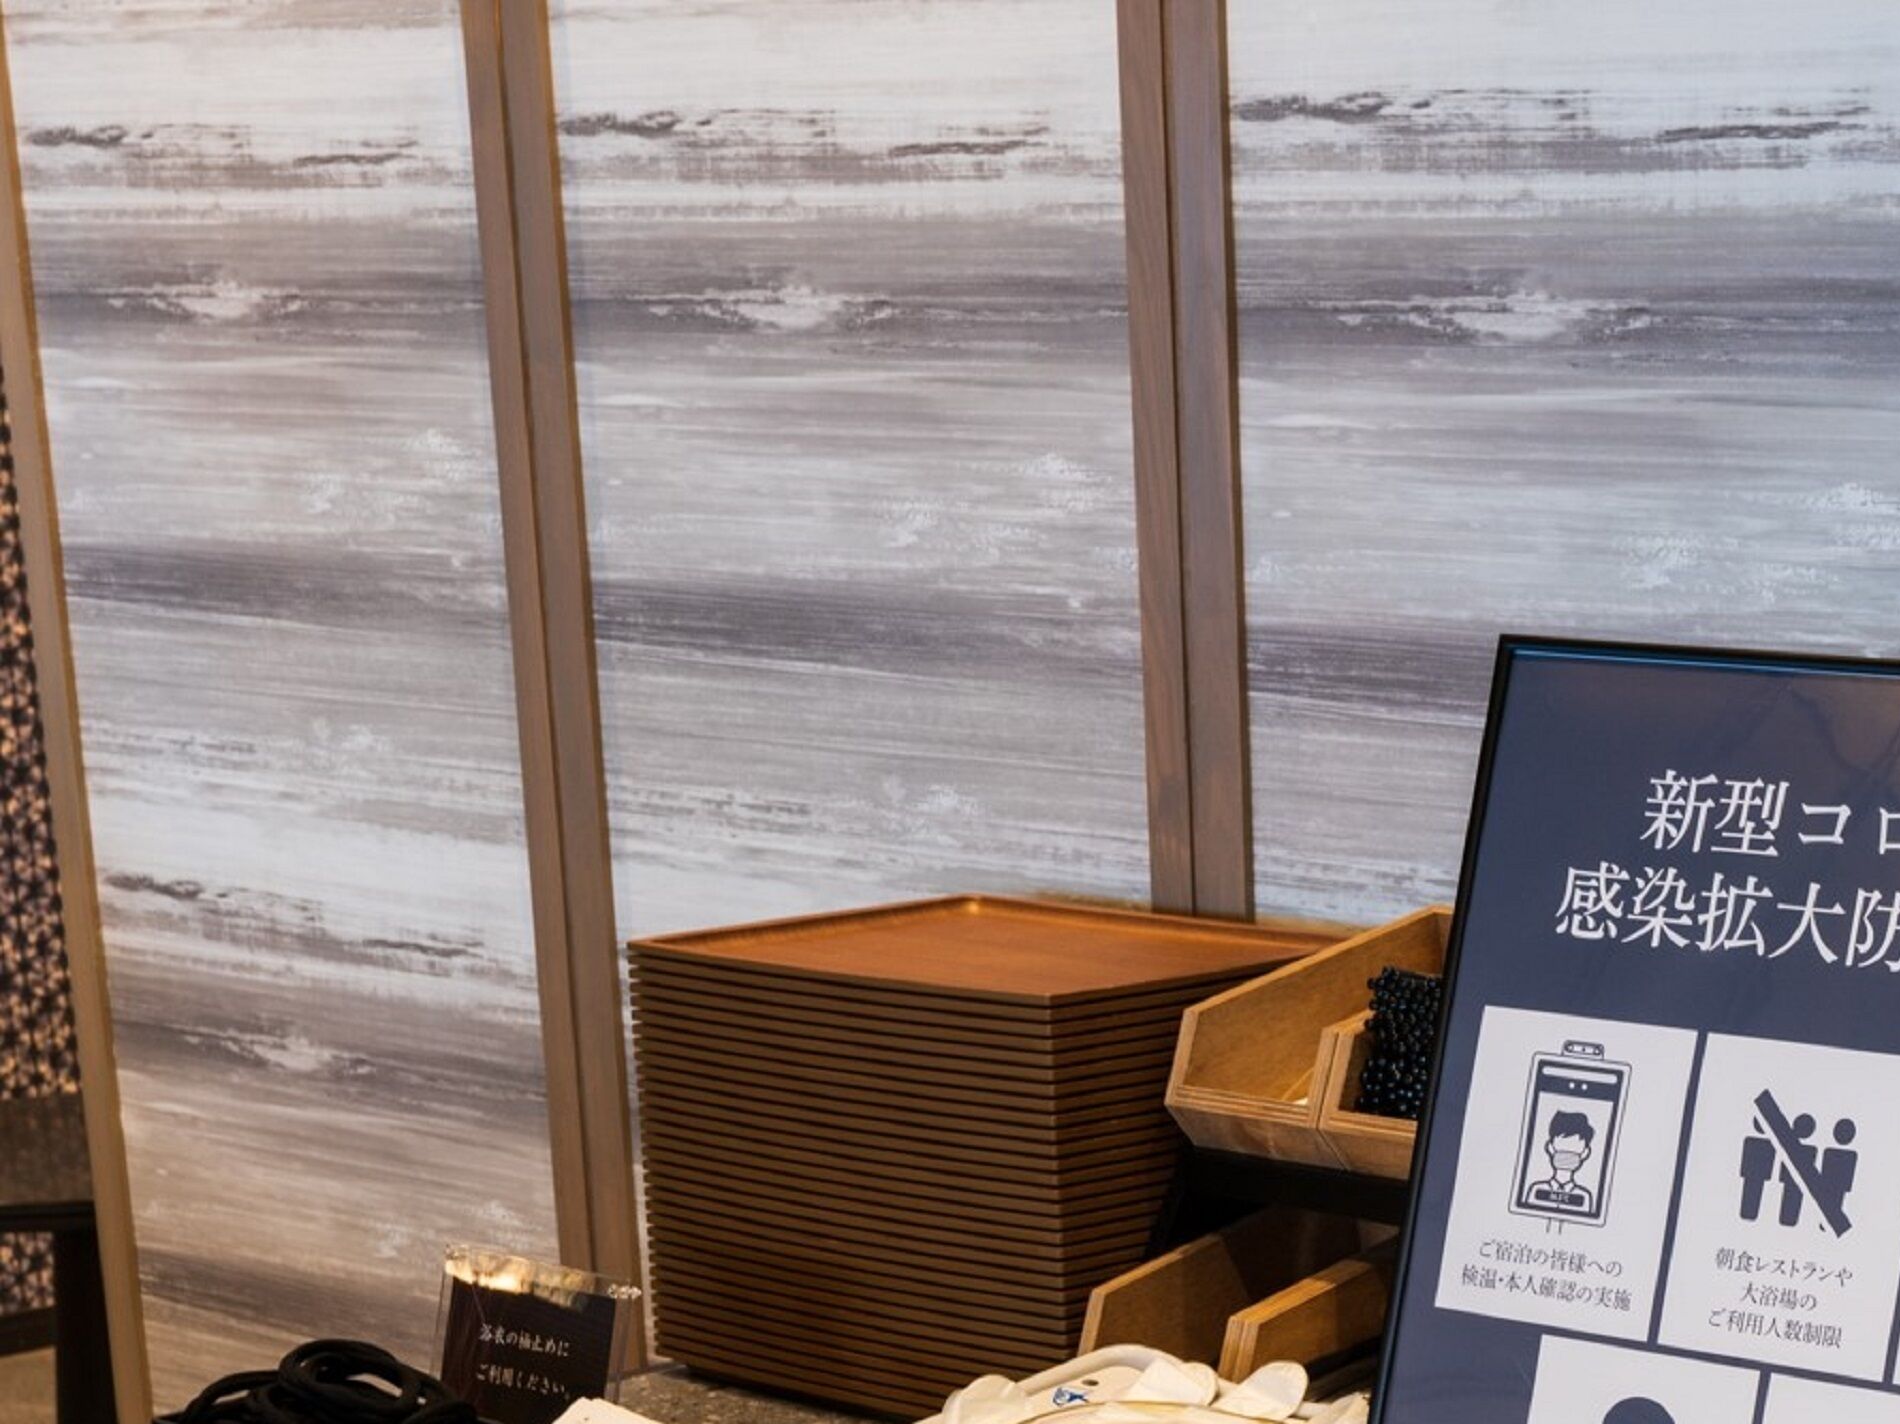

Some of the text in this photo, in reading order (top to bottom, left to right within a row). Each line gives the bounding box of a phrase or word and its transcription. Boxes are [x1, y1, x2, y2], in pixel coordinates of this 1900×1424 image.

[1477, 1239, 1624, 1279] ご宿泊の皆様への
[1714, 1246, 1854, 1287] 朝食レストランや
[1740, 1281, 1819, 1312] 大浴場の
[1707, 1307, 1843, 1350] ご利用人数制限
